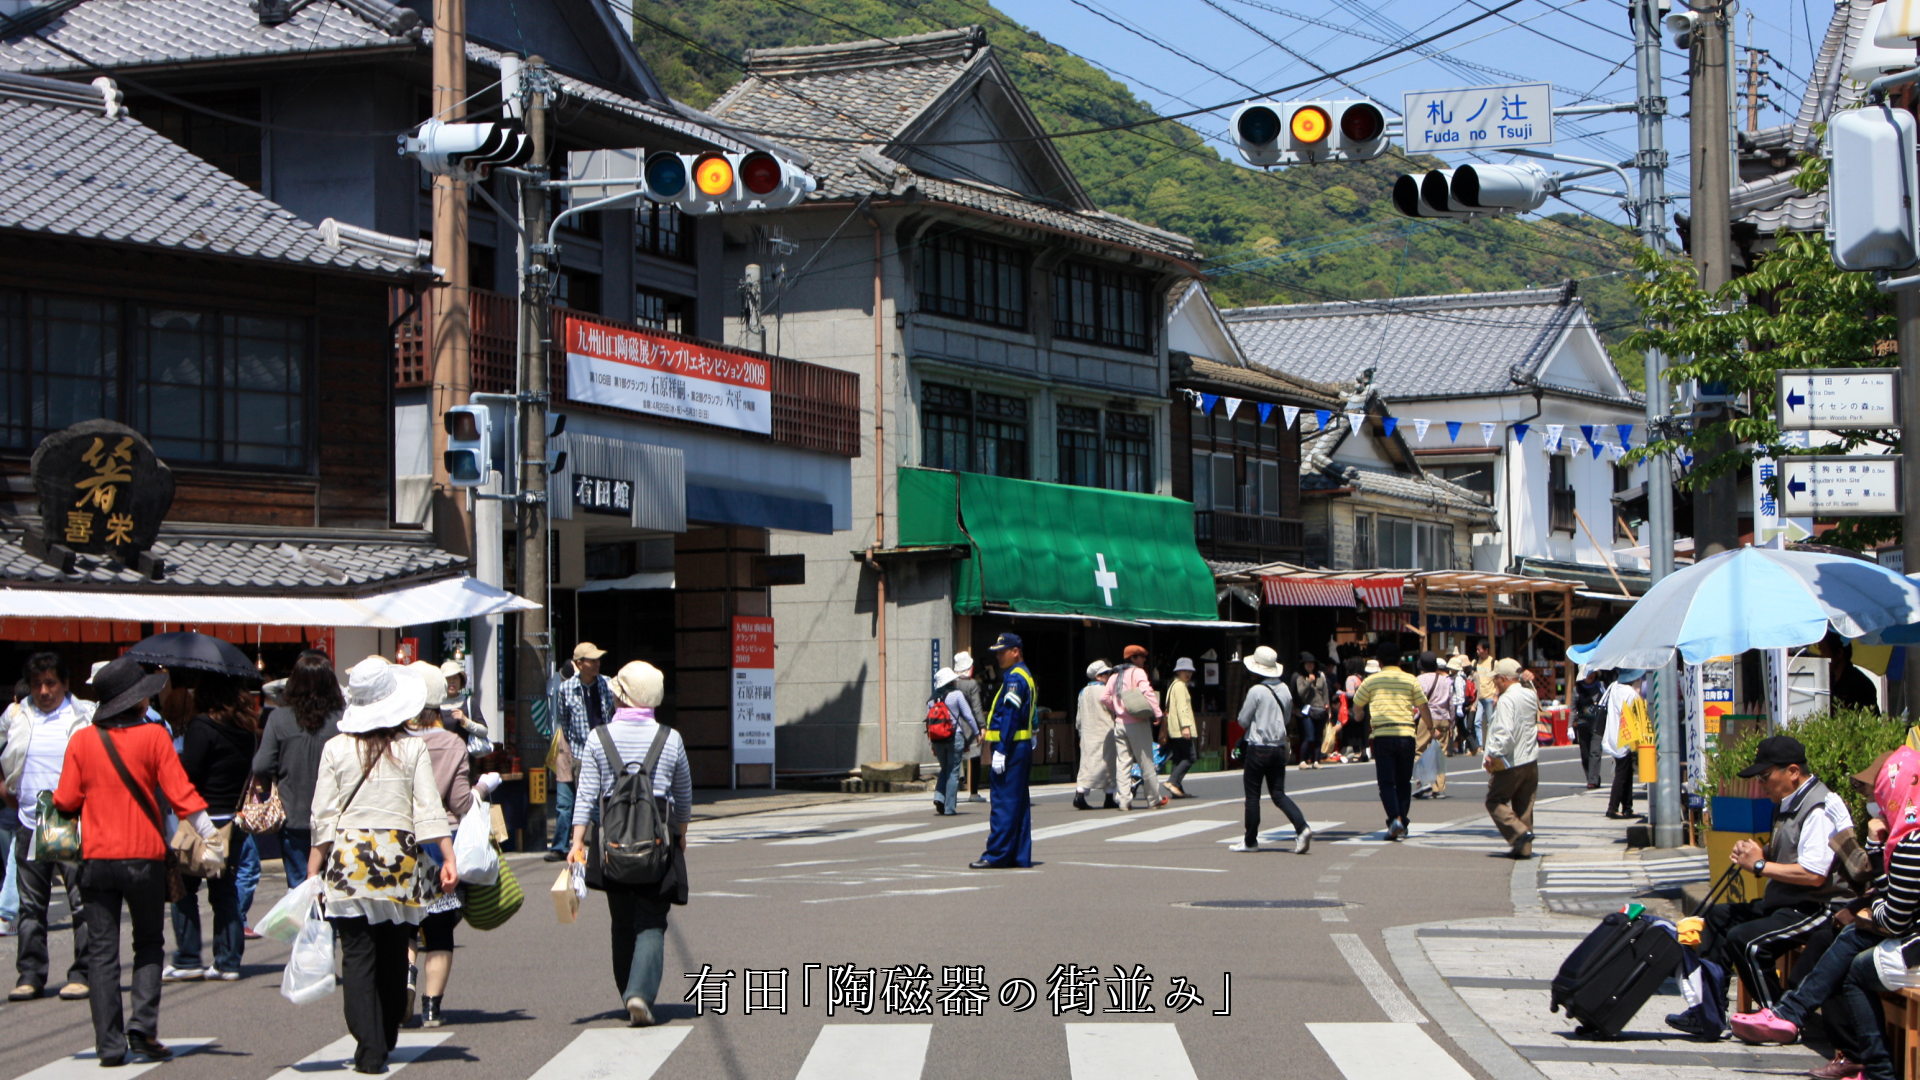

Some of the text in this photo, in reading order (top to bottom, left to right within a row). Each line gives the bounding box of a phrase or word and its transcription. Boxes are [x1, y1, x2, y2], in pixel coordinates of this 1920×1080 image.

[1427, 94, 1528, 125] 札ノ辻
[1425, 124, 1532, 143] Fuda no Tsuji
[577, 326, 766, 386] 九州山口陶磁展グランプリエキシビション2009
[1807, 377, 1869, 386] 有田ダム
[726, 389, 742, 410] 六平
[1808, 402, 1869, 411] マイセンの森
[1808, 465, 1871, 474] 天狗谷窯跡
[576, 476, 630, 509] 有田館
[1809, 488, 1871, 497] 李参平墓
[736, 633, 757, 642] グランプリ
[736, 644, 767, 653] エキシビション
[736, 654, 750, 663] 2009
[737, 707, 755, 721] 六平
